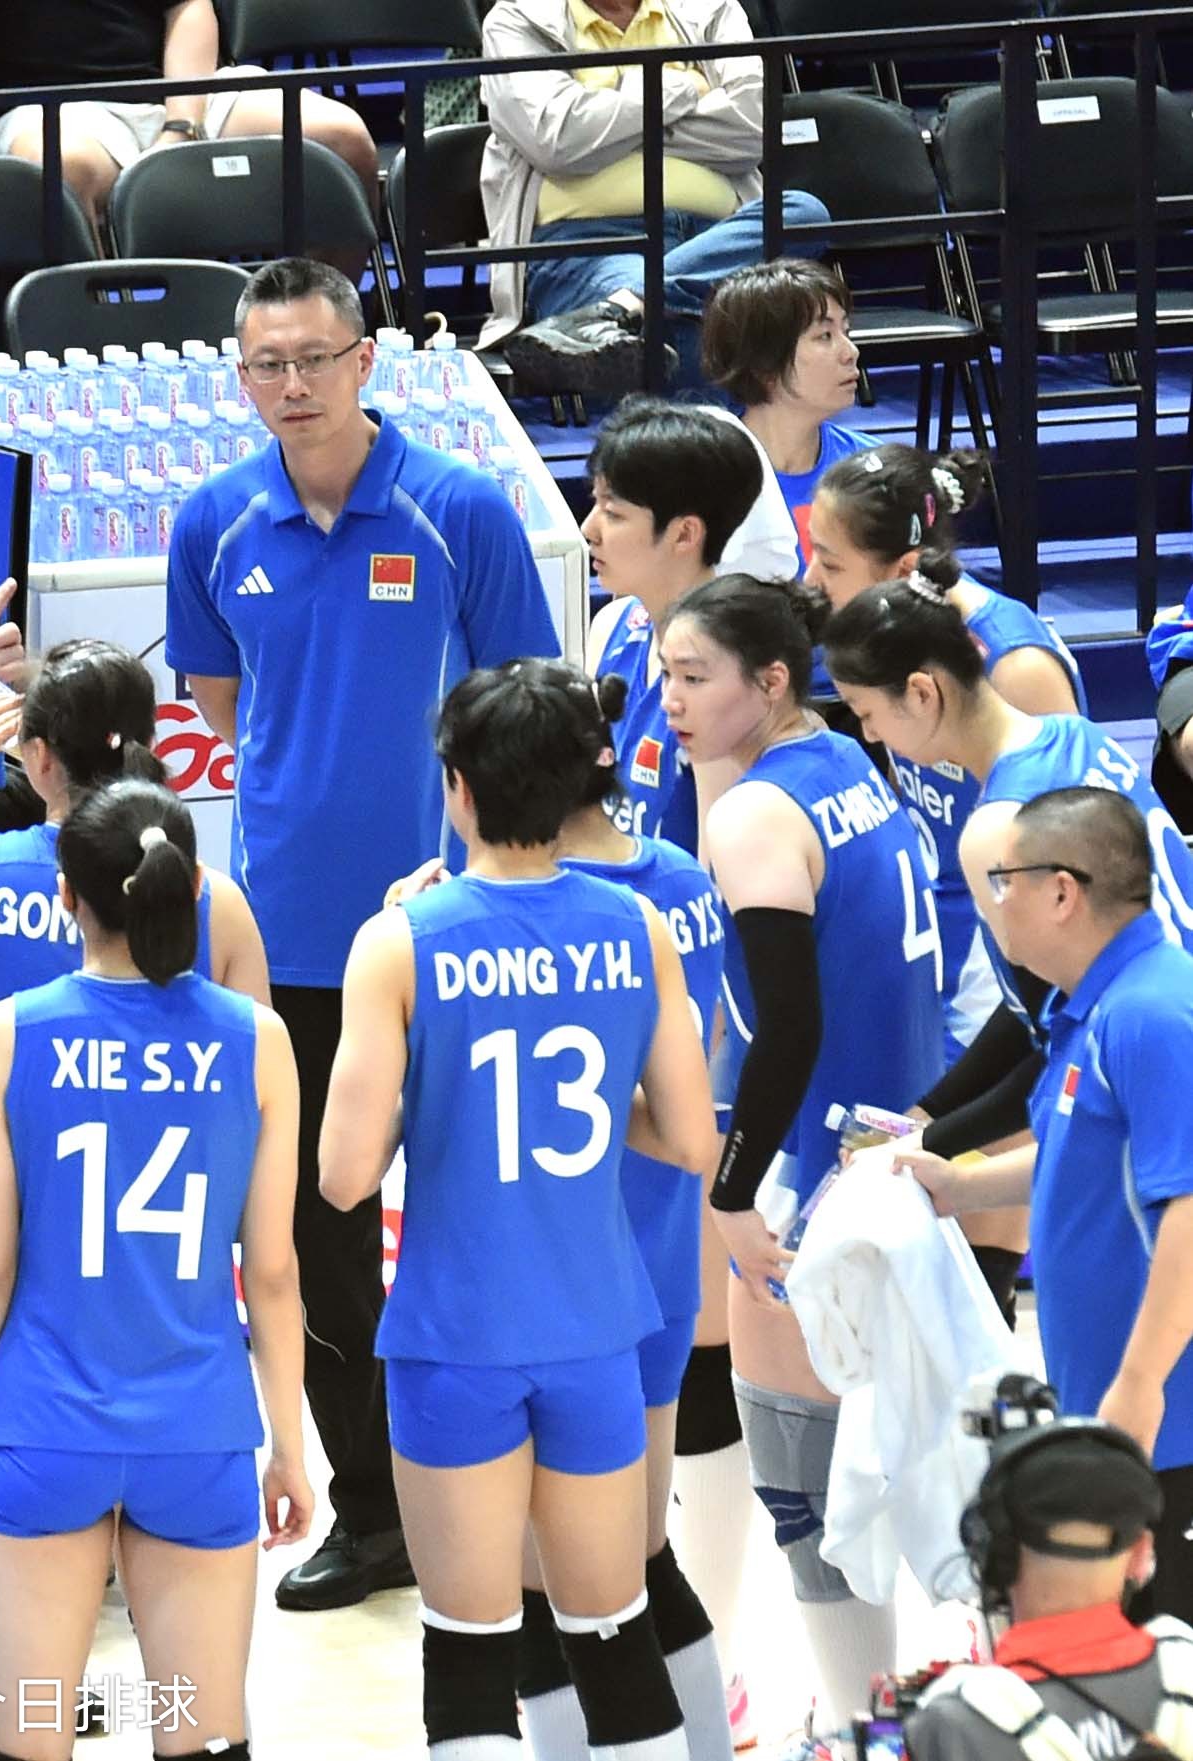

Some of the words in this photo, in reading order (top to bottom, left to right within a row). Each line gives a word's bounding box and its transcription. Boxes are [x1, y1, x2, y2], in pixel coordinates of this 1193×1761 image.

[375, 585, 408, 597] CHN
[899, 763, 954, 826] aier
[896, 848, 944, 994] 4
[434, 946, 558, 1001] DONG
[564, 940, 642, 993] Y.H.
[51, 1038, 127, 1091] XIE
[141, 1041, 222, 1092] S.Y.
[470, 1024, 612, 1184] 13
[57, 1121, 208, 1281] 14
